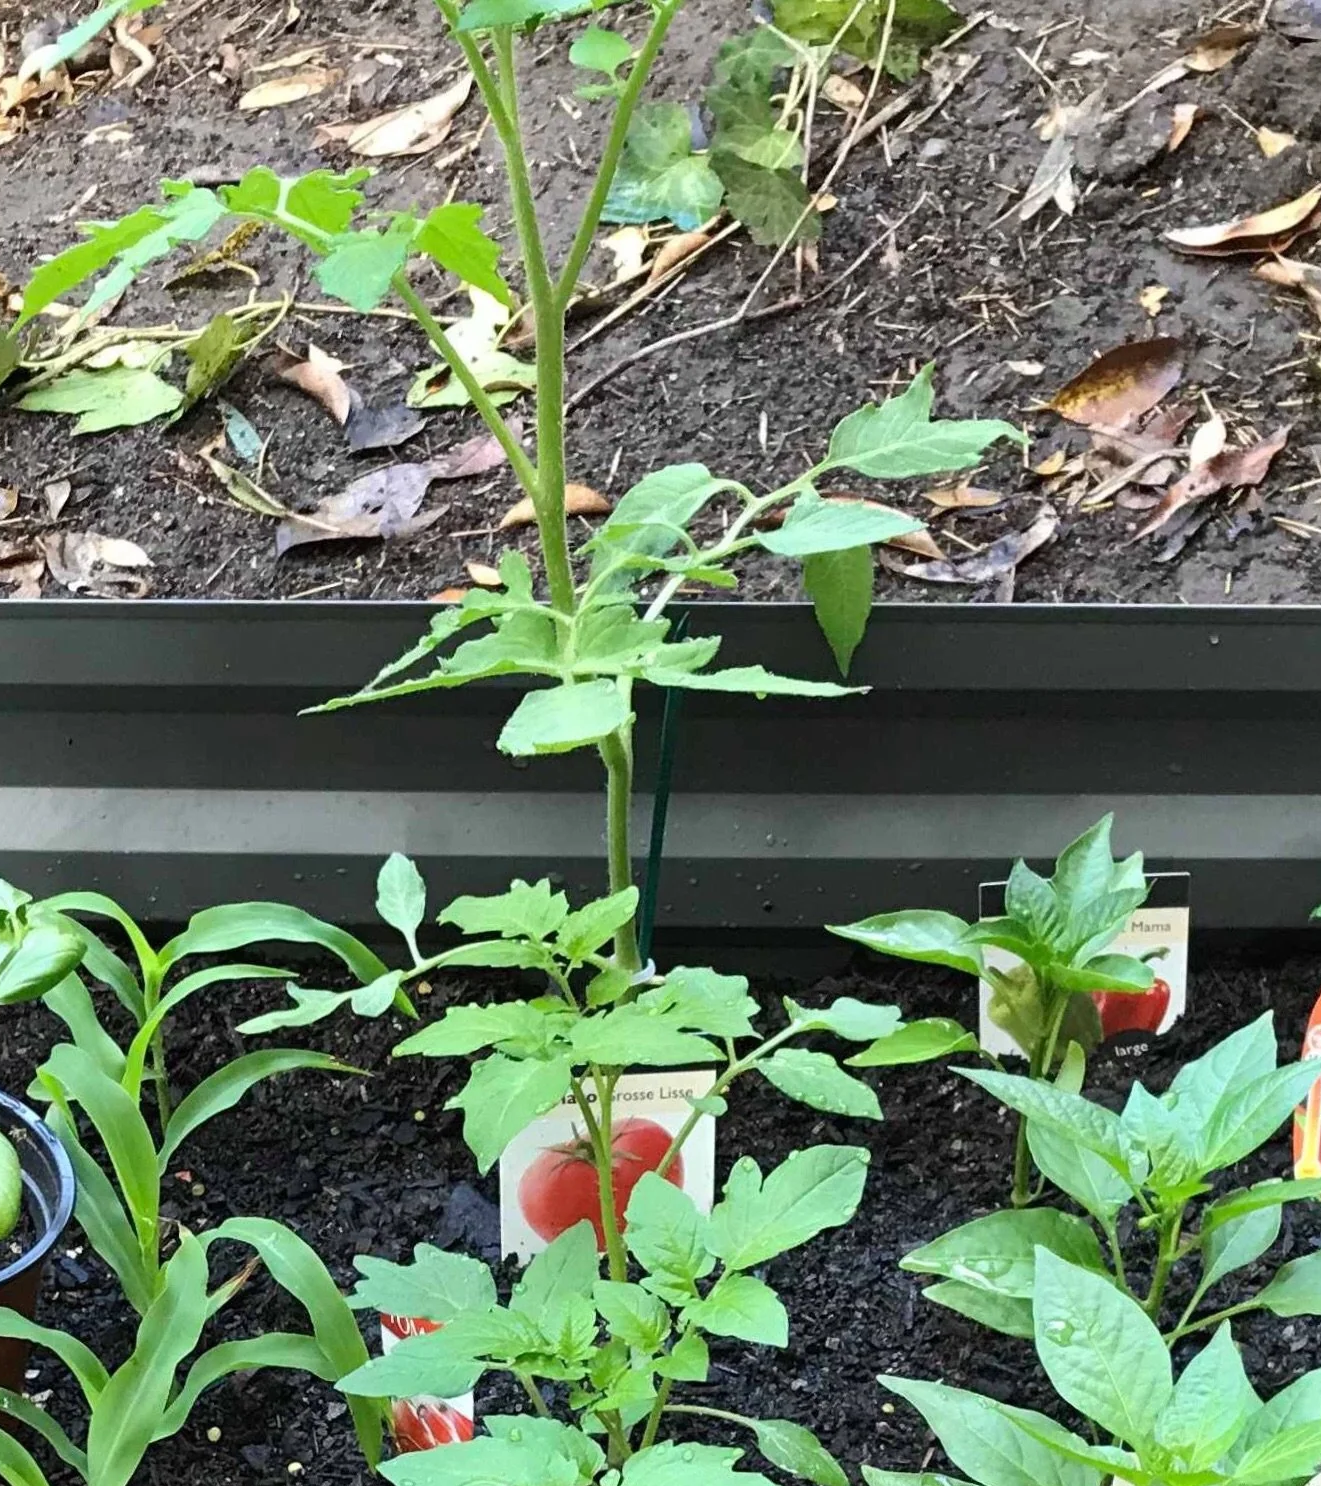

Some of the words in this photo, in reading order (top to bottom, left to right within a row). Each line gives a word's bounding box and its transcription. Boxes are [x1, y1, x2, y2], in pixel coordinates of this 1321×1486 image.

[1131, 921, 1171, 933] Mama
[1114, 1043, 1149, 1057] large
[611, 1089, 655, 1102] rosse
[659, 1086, 693, 1100] Lisse
